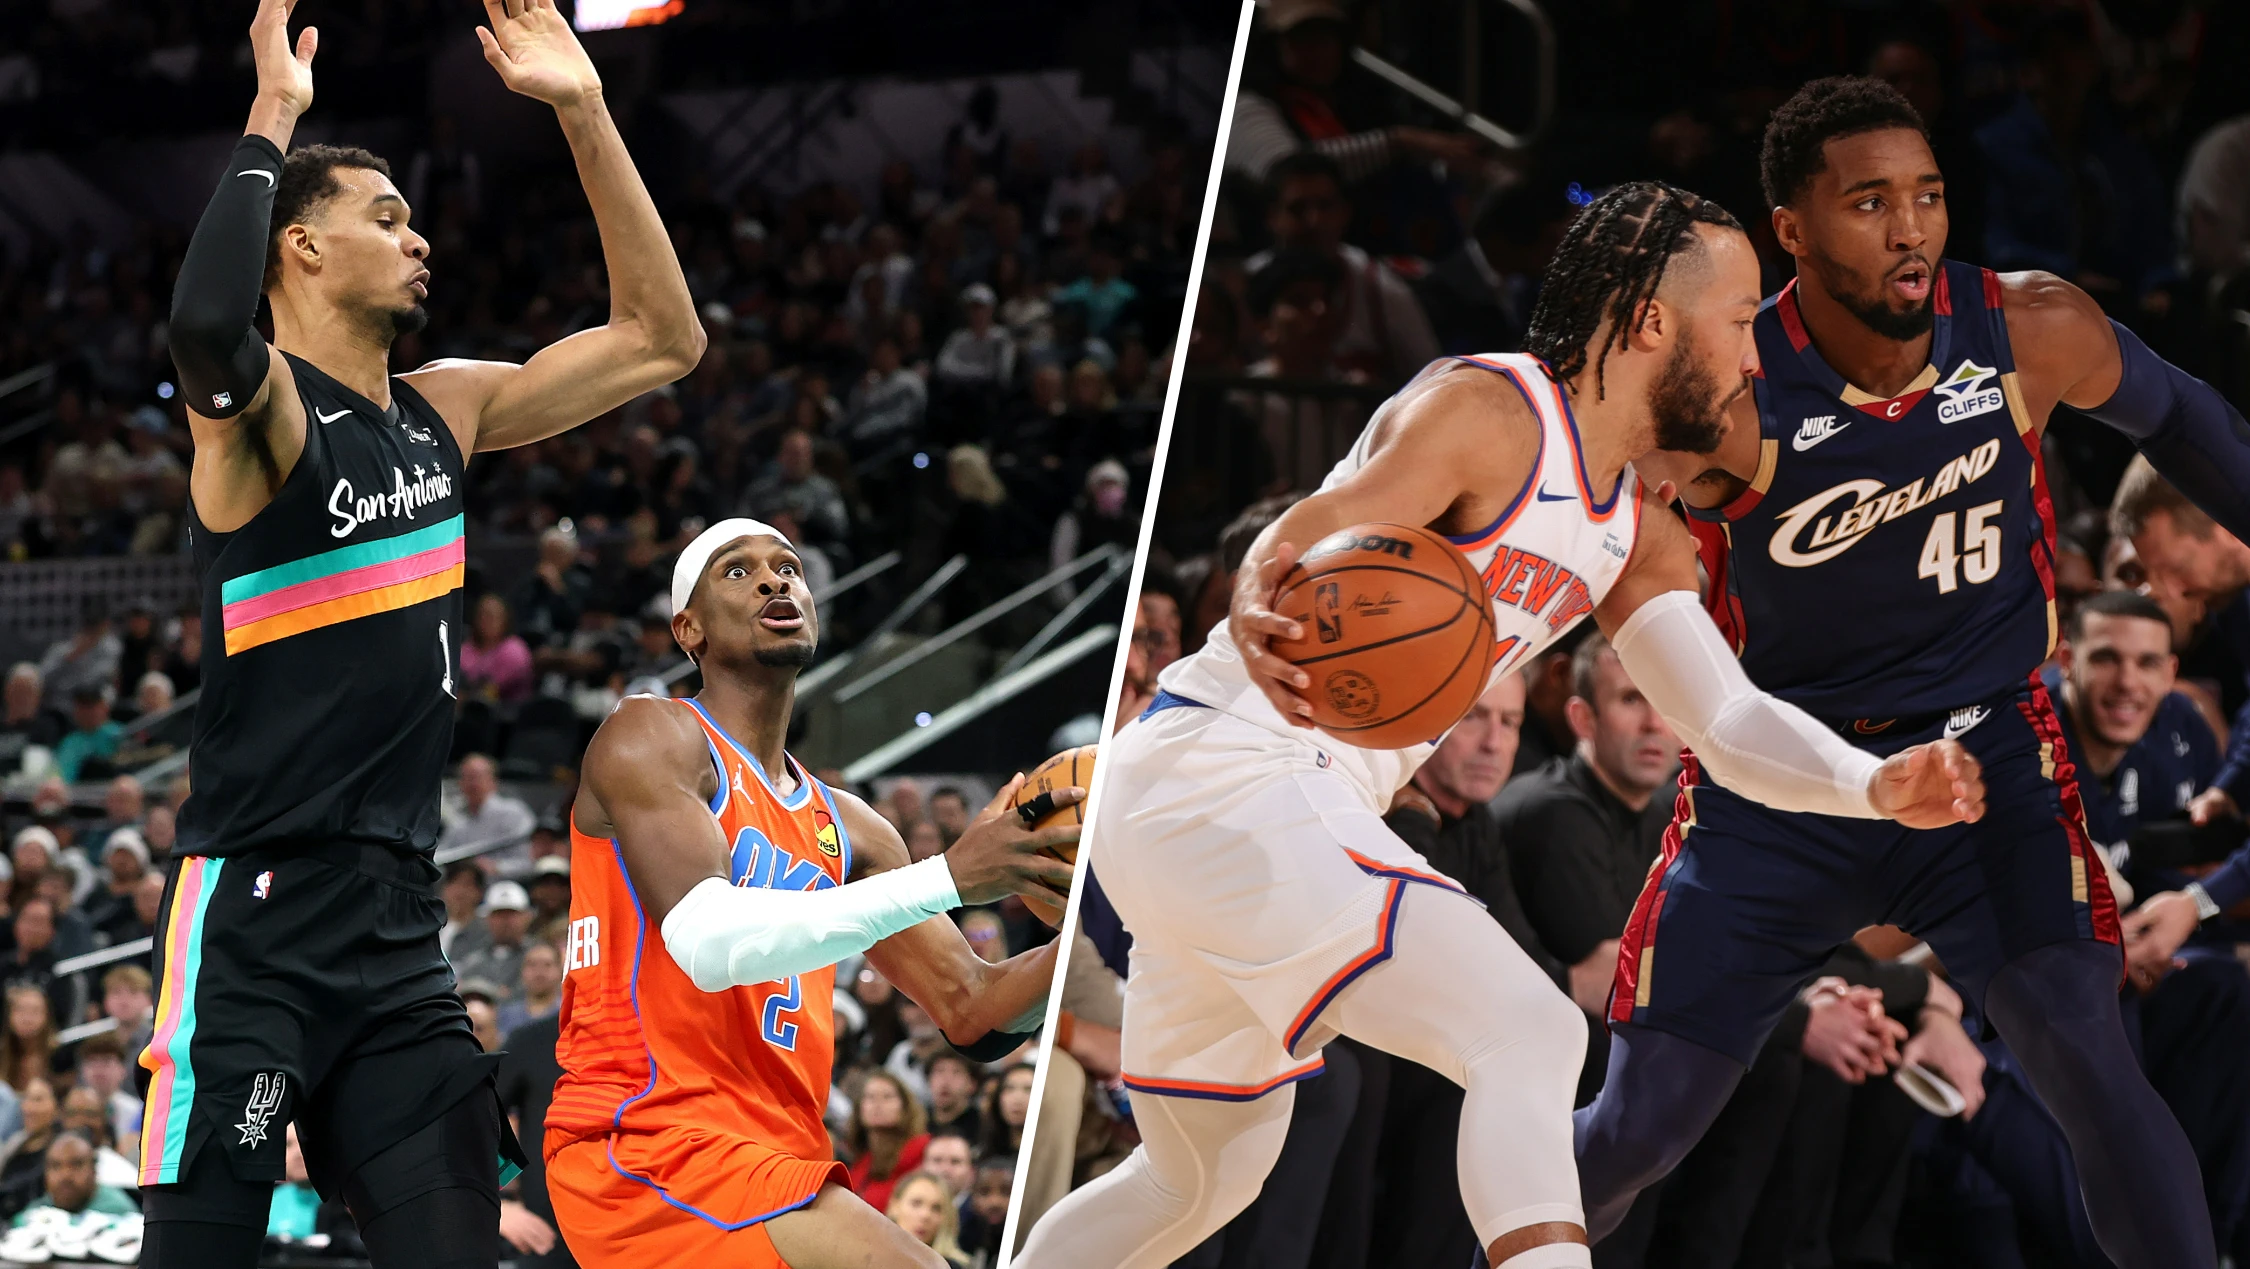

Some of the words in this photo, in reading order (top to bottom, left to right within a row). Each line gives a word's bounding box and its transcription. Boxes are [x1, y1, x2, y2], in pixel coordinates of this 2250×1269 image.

[1801, 415, 1836, 438] NIKE
[1886, 401, 1902, 417] C
[1941, 392, 2000, 419] CLIFFS
[328, 478, 387, 538] San
[387, 462, 452, 520] Antonio
[1768, 437, 2001, 568] CLEVELAND
[1481, 543, 1574, 619] NEW
[1918, 499, 2003, 595] 45
[1949, 705, 1982, 729] NIKE
[731, 825, 839, 892] OK
[562, 915, 600, 984] ER
[761, 974, 802, 1053] 2
